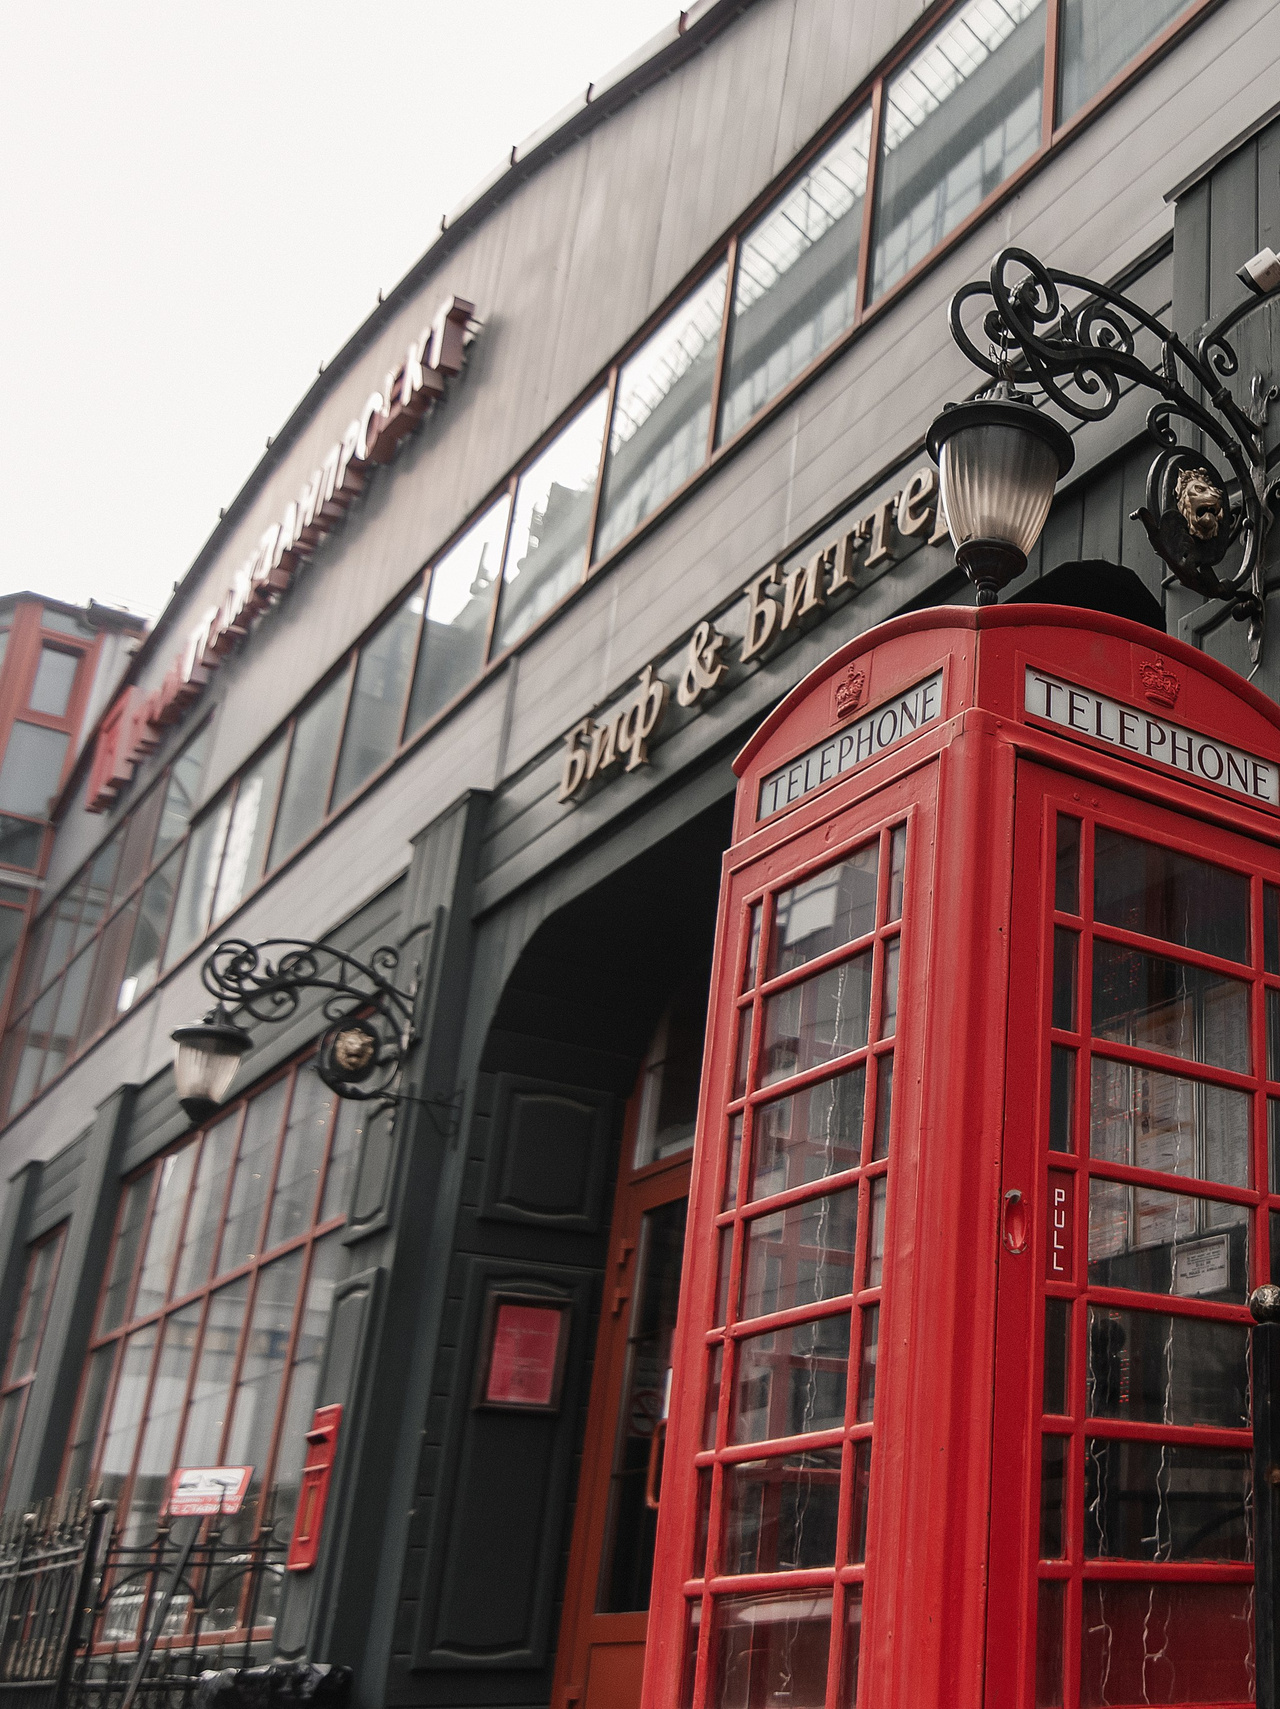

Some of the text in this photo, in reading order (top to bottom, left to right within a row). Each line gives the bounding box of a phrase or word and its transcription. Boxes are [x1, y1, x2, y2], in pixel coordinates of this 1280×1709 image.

[558, 466, 951, 804] Биф & Битте
[768, 681, 938, 804] TELEPHONE
[1034, 676, 1271, 801] TELEPHONE
[1053, 1187, 1065, 1271] PULL
